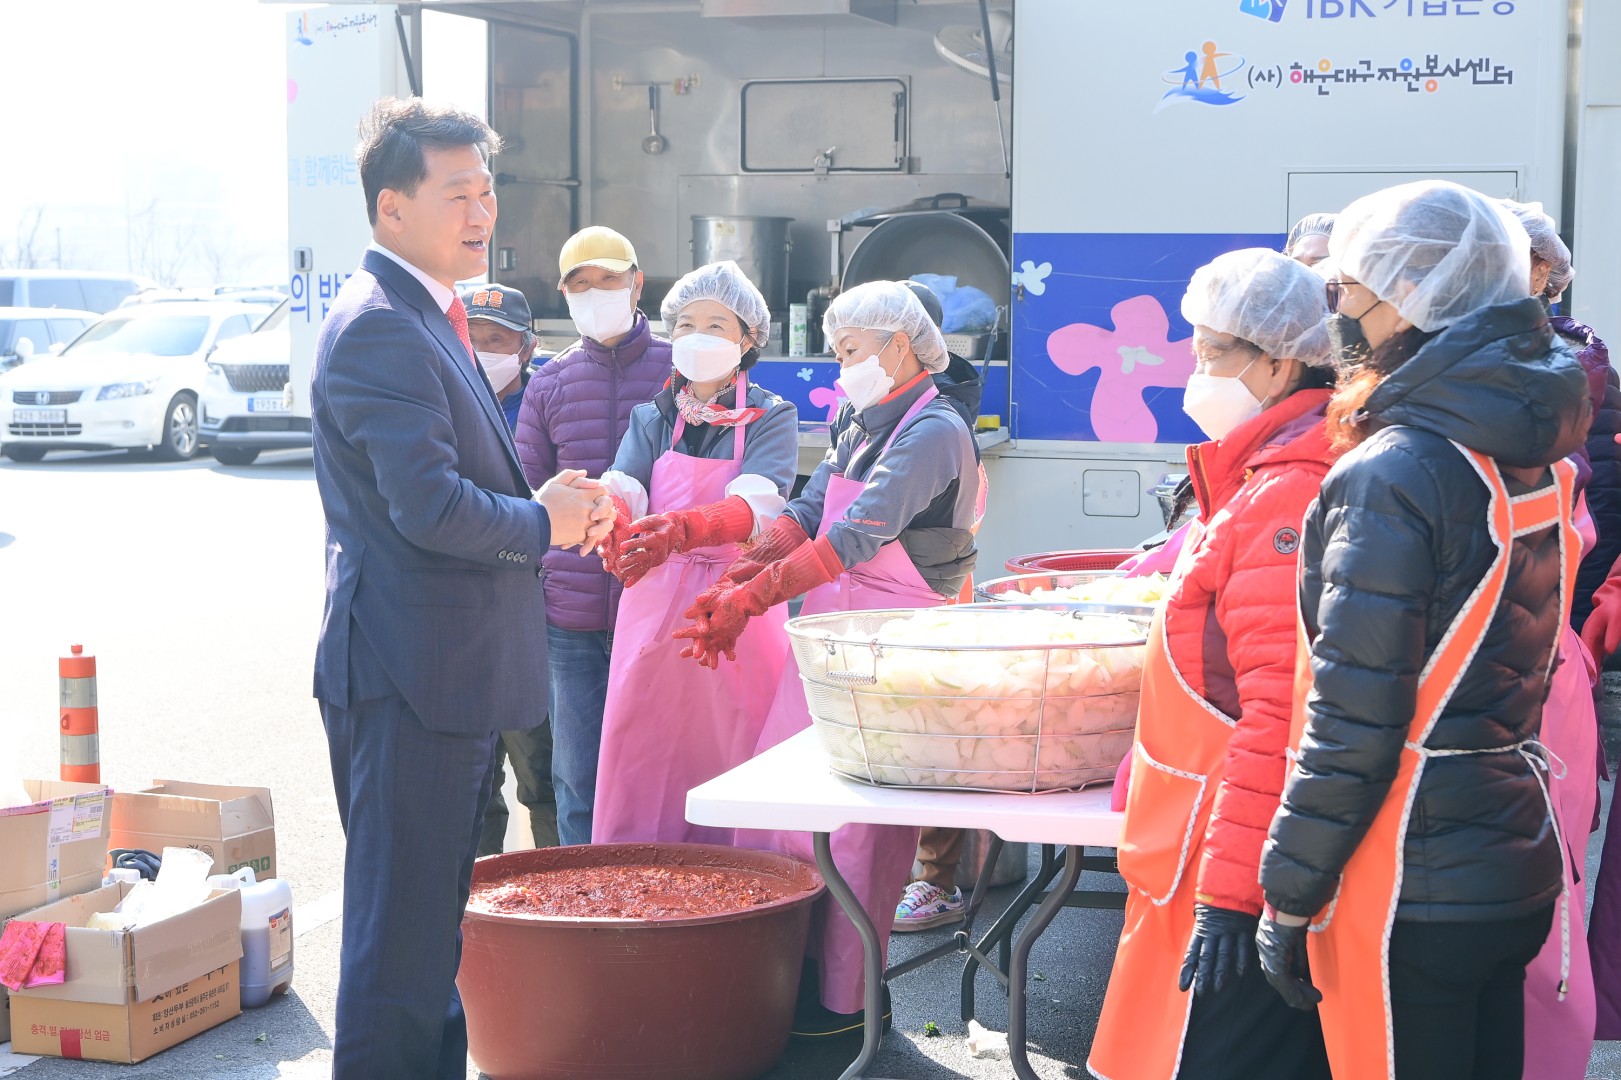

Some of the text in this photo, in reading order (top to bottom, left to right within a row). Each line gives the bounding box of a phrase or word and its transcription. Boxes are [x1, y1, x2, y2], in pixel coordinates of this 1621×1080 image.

[304, 154, 359, 187] 함께하는
[290, 272, 353, 323] 의 밥
[94, 1030, 111, 1041] 엄금
